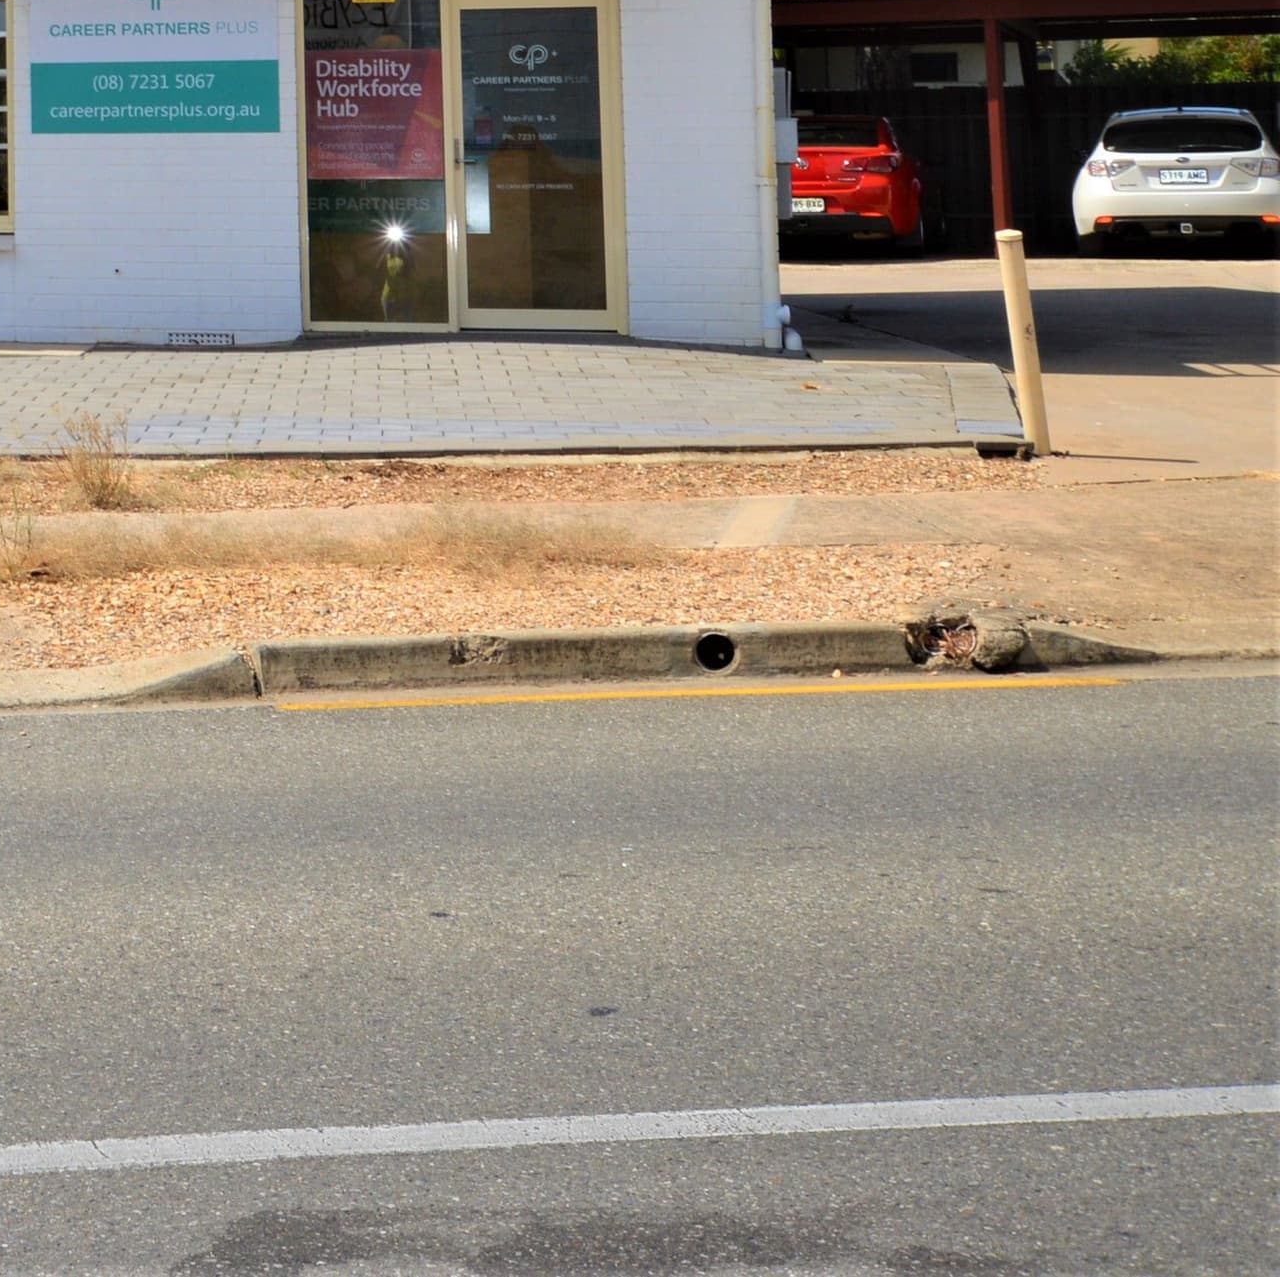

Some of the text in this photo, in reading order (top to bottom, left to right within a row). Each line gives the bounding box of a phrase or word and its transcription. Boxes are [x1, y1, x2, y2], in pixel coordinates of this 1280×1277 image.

[49, 20, 259, 37] CAREER PARTNERS PLUS
[315, 58, 411, 81] Disability
[92, 74, 216, 92] (08) 7231 5067
[316, 79, 423, 98] Workforce
[473, 76, 511, 84] CAREER
[512, 75, 563, 84] PARTNERS
[49, 101, 261, 122] careerpartnersplus.org.au
[316, 99, 359, 118] Hub
